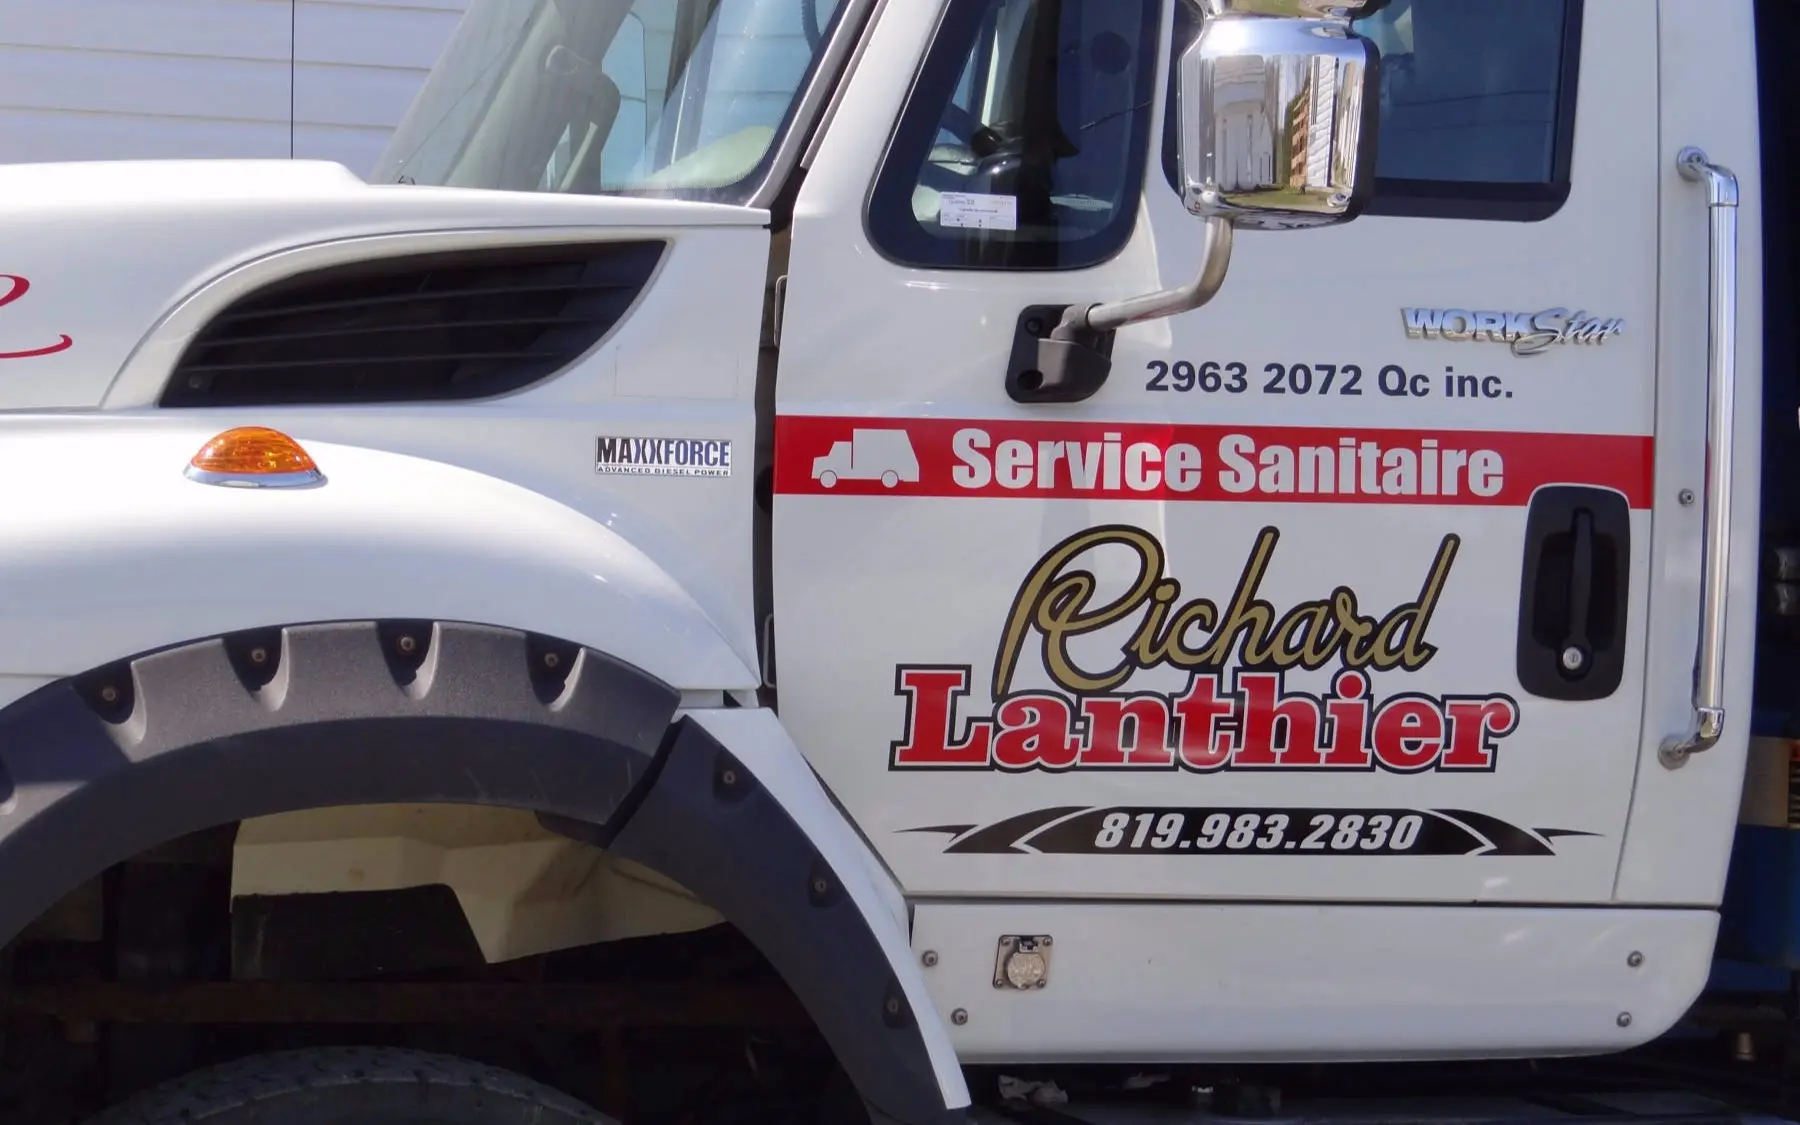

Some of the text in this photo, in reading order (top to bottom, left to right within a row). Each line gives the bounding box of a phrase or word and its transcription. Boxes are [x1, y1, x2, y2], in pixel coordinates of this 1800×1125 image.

[1145, 360, 1513, 399] 2963 2072 Qc inc.
[597, 437, 730, 467] MAXXFORCE
[598, 466, 651, 475] ADVANCED
[654, 467, 690, 475] DIESEL
[951, 428, 1504, 497] Service Sanitaire
[993, 524, 1461, 697] Richard
[889, 664, 1521, 774] Lanthier
[1094, 813, 1424, 850] 819.983.2830
